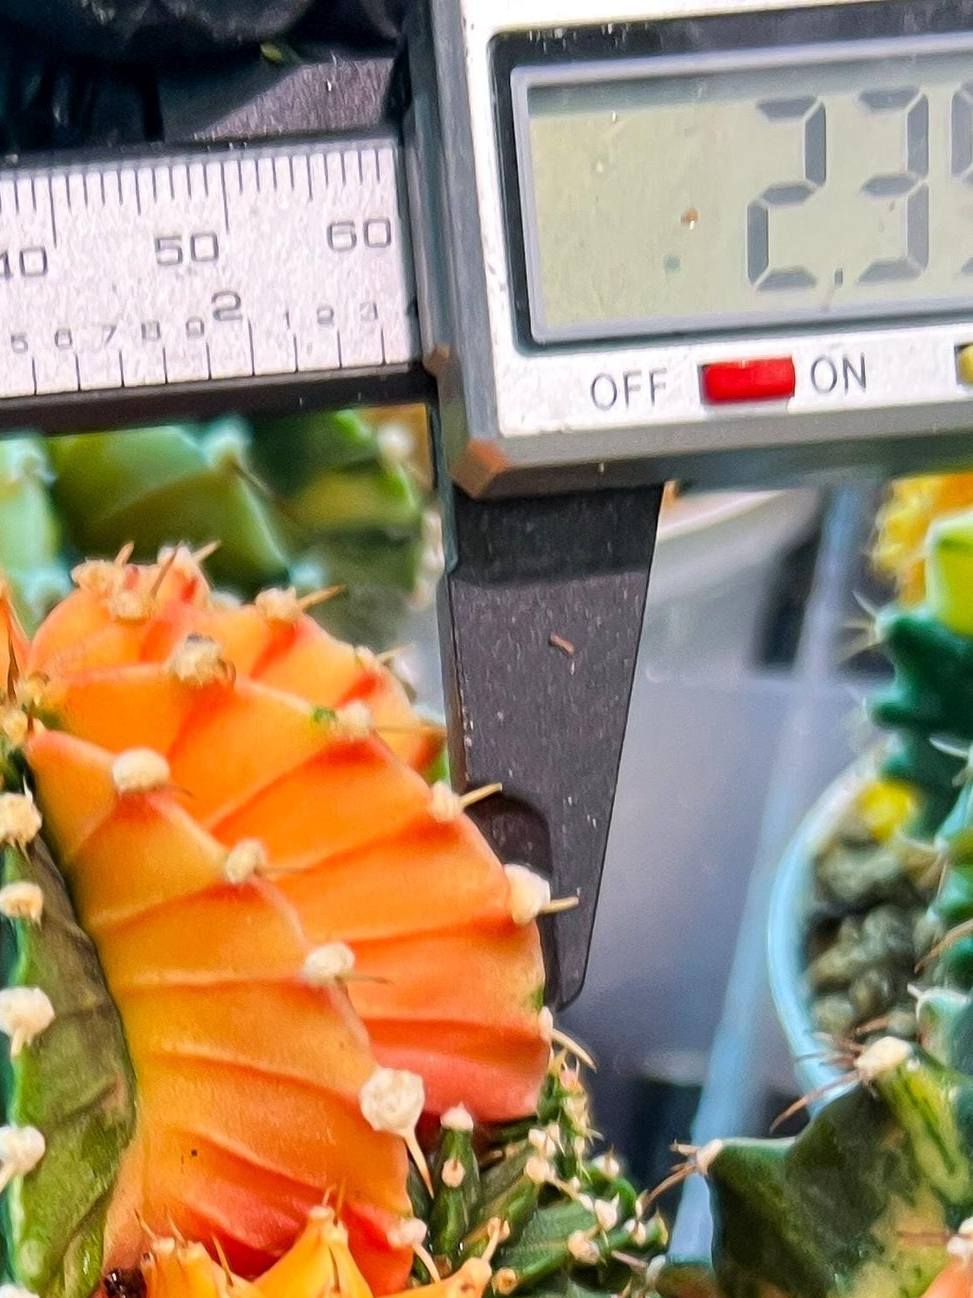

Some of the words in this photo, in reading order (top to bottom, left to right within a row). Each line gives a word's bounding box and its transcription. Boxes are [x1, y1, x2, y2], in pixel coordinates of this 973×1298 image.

[154, 231, 219, 266] 50
[327, 217, 392, 251] 60
[101, 324, 117, 344] 7
[211, 290, 244, 322] 2
[590, 367, 669, 411] OFF
[810, 352, 867, 396] ON
